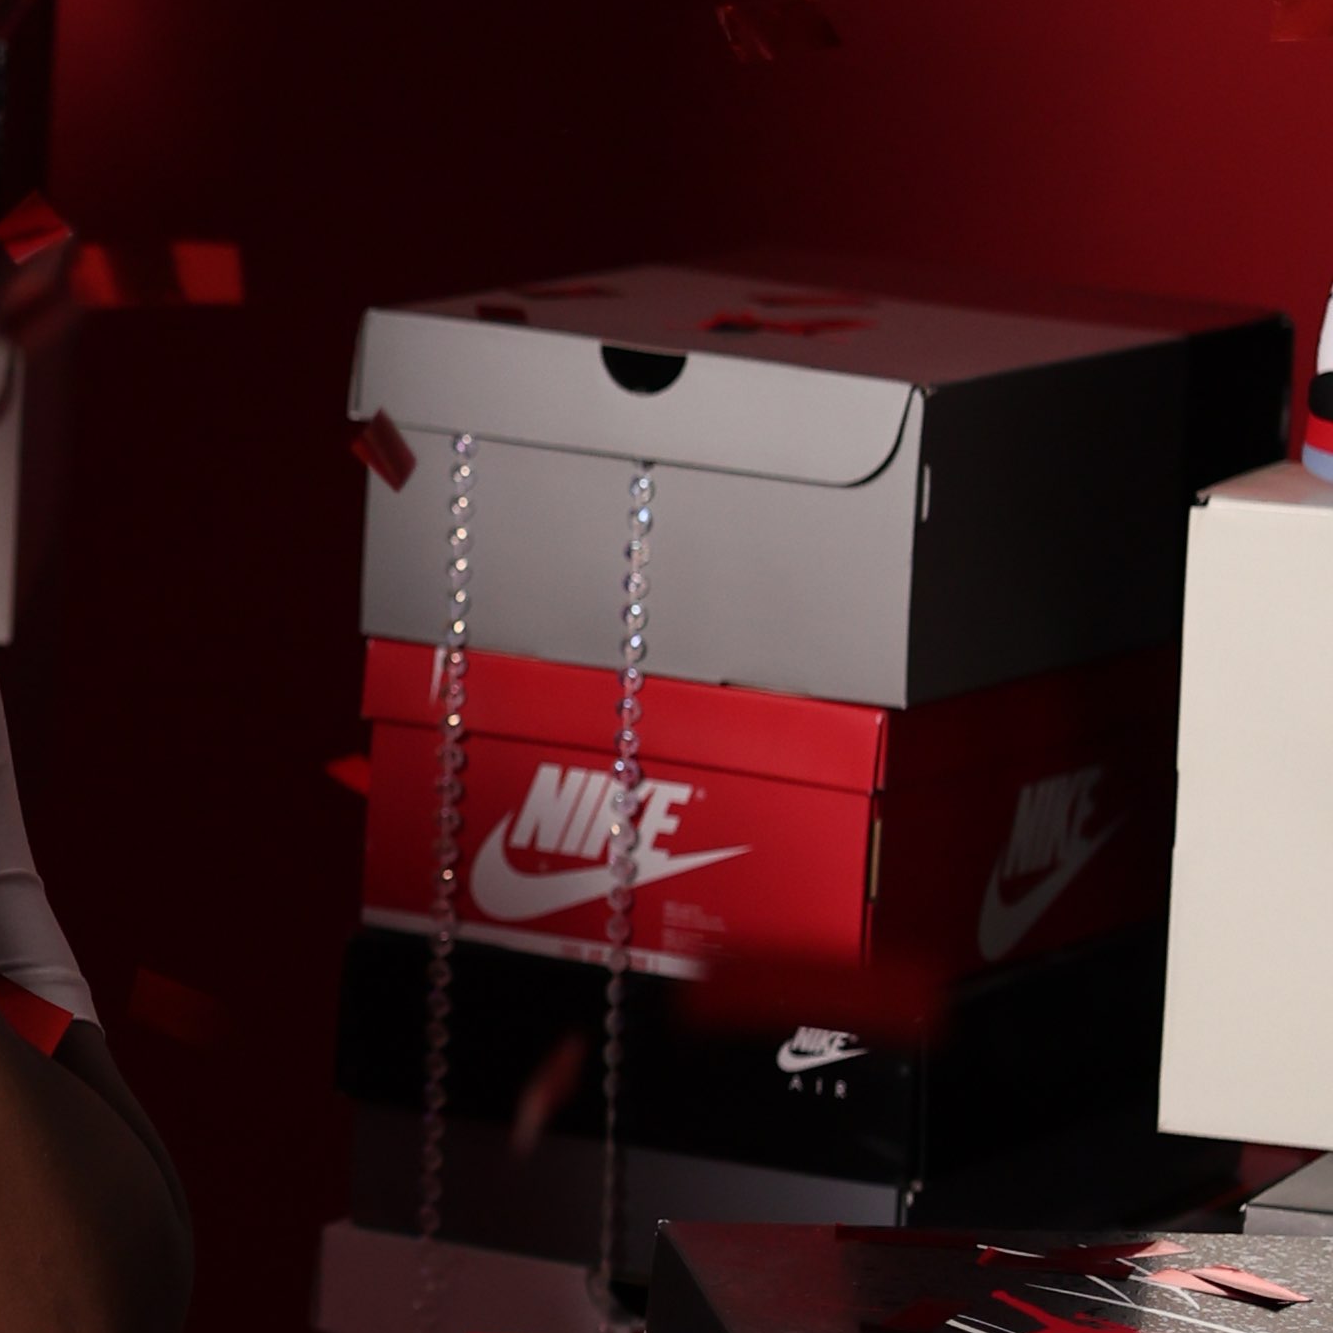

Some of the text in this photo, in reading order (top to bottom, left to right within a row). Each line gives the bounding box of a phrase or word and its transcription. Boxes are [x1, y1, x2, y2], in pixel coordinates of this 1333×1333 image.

[508, 762, 693, 861] NIKE
[1002, 764, 1103, 880] NIKE
[792, 1025, 851, 1056] NIKE
[788, 1073, 848, 1100] AIR
